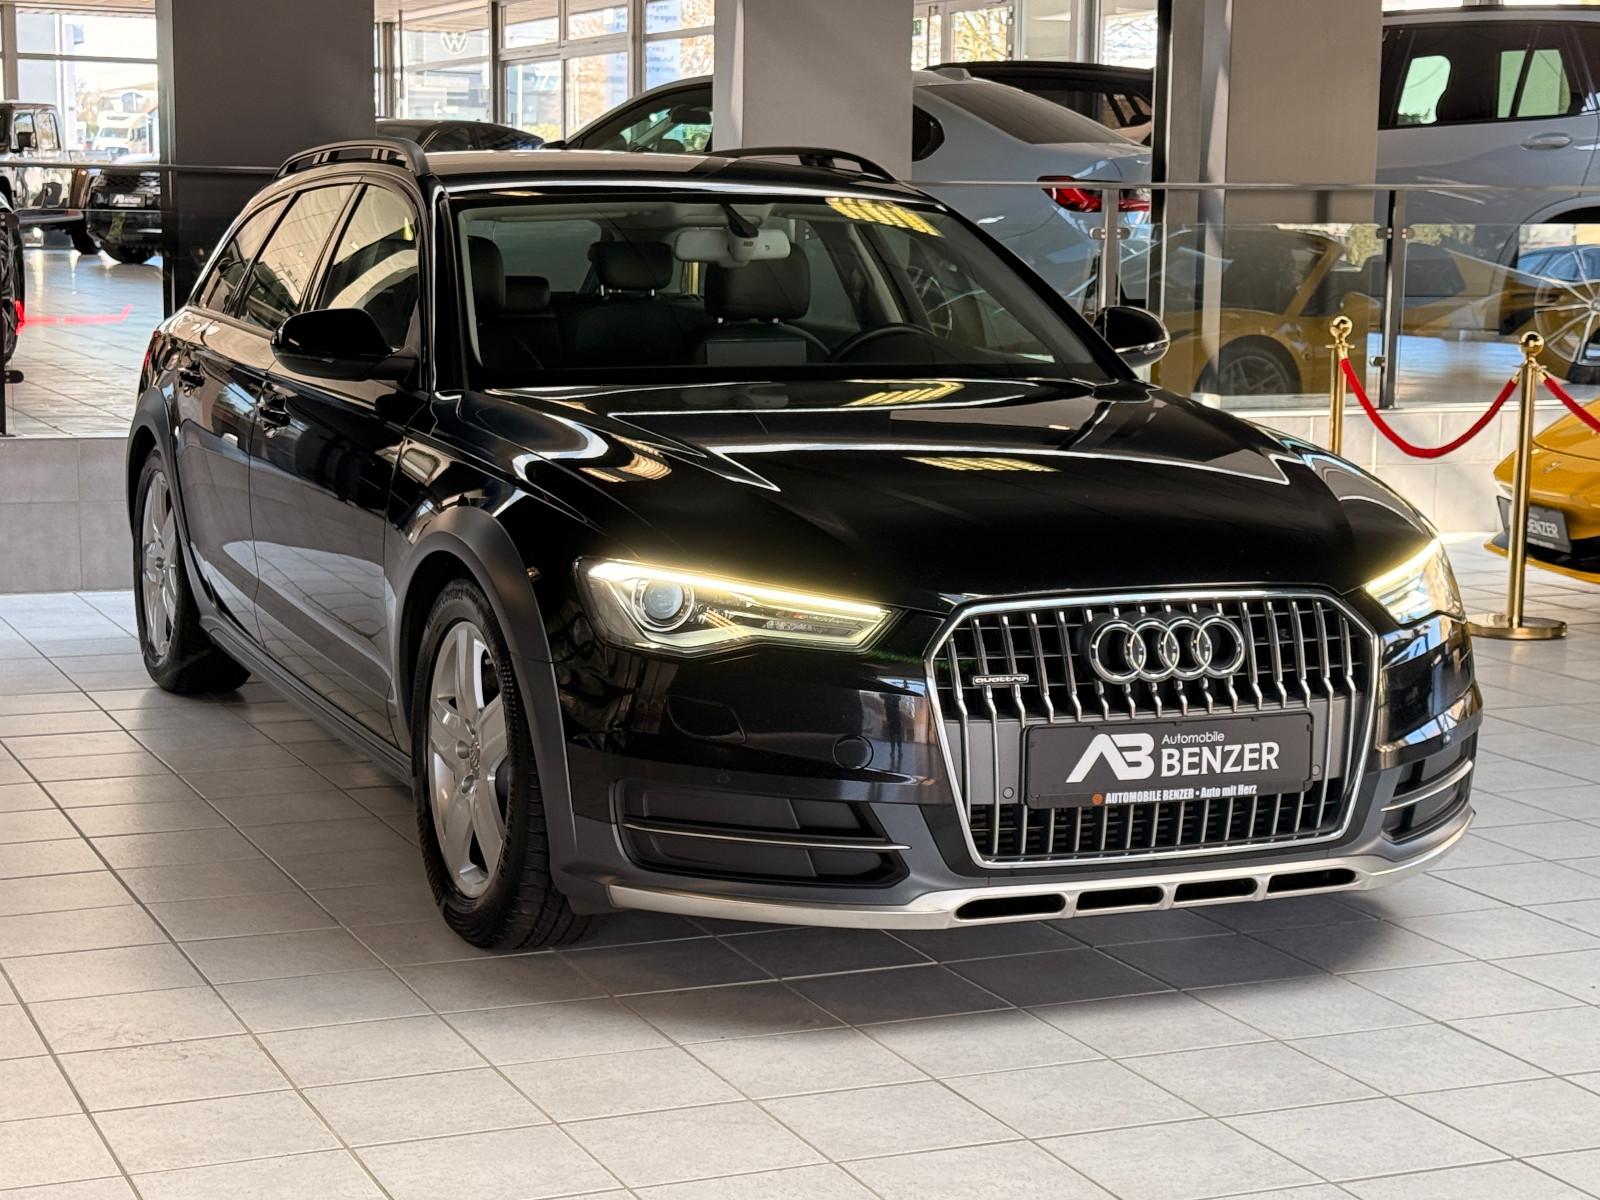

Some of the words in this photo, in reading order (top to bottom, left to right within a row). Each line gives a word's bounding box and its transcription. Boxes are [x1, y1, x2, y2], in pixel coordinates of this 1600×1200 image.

[1527, 518, 1560, 538] ENZER
[1162, 732, 1225, 745] Automobile
[1160, 741, 1280, 777] BENZER
[1105, 790, 1162, 804] AUTOMOBILE
[1162, 788, 1194, 801] BENZER
[1200, 787, 1221, 798] Auto
[1222, 785, 1237, 797] mit
[1238, 784, 1258, 795] Herz
